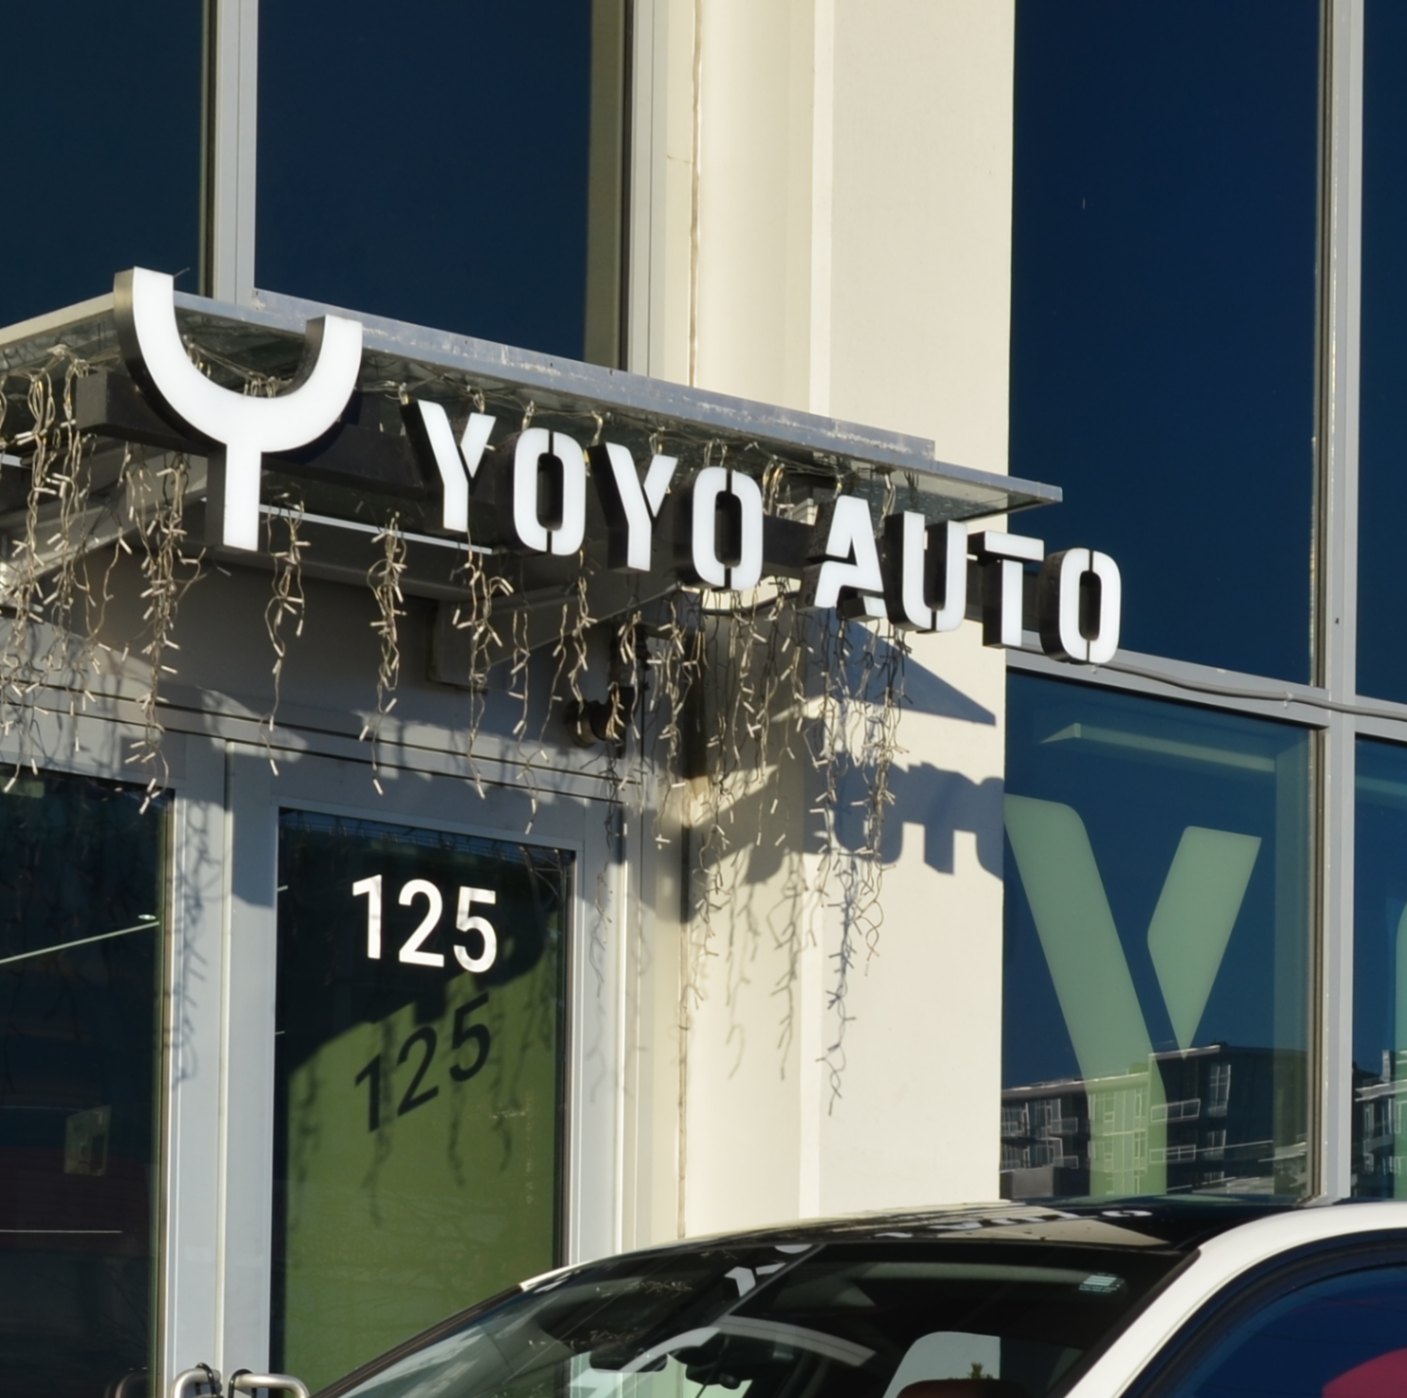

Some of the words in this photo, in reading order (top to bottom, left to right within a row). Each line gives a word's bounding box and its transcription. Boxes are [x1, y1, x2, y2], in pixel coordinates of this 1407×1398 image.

[416, 399, 764, 591] YOYO
[813, 494, 1122, 665] AUTO
[352, 874, 497, 973] 125
